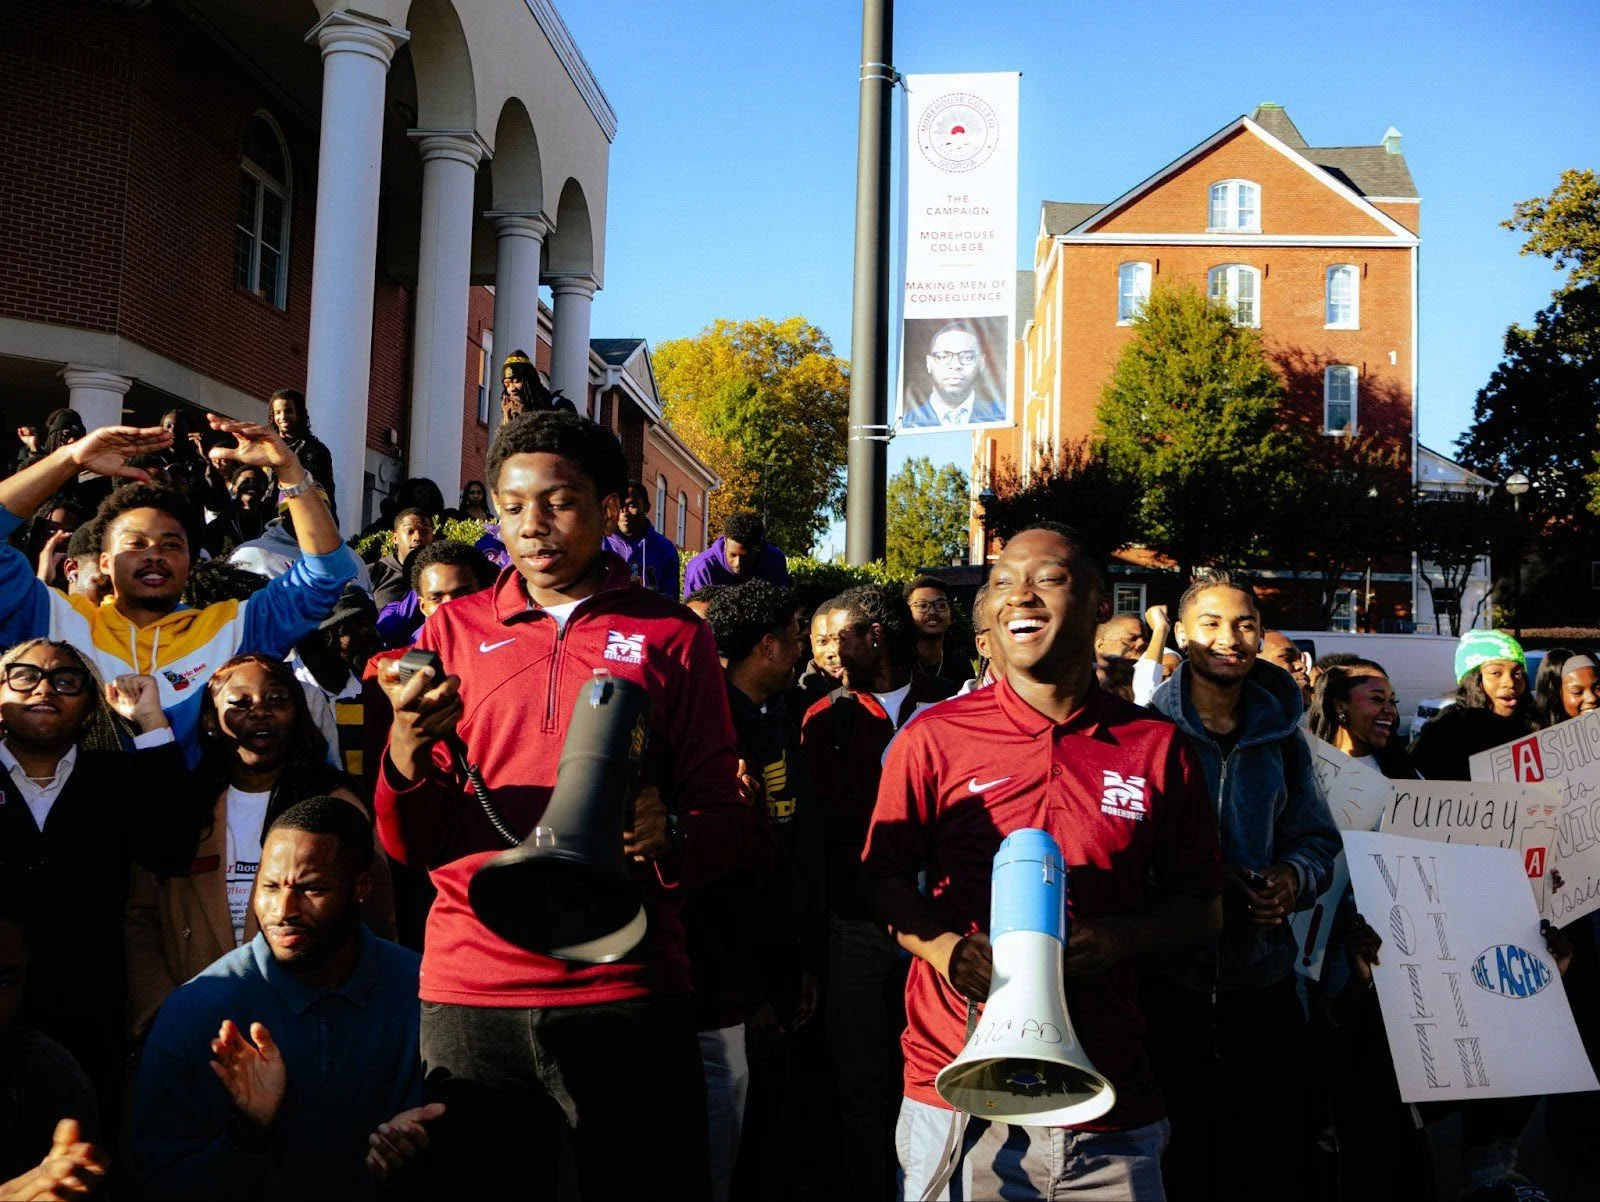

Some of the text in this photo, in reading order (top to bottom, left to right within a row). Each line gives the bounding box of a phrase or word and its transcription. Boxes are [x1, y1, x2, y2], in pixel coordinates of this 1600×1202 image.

[921, 95, 965, 132] MOREHOUSE
[947, 194, 969, 203] THE
[926, 207, 990, 216] CAMPAIGN
[920, 230, 995, 240] MOREHOUSE
[930, 243, 984, 252] COLLEGE
[906, 280, 1007, 291] MAKING MEN OF
[910, 292, 1002, 303] CONSEQUENCE
[1490, 712, 1600, 784] FASHIO
[1101, 804, 1145, 821] MOREHOUSE
[1391, 792, 1518, 849] runway
